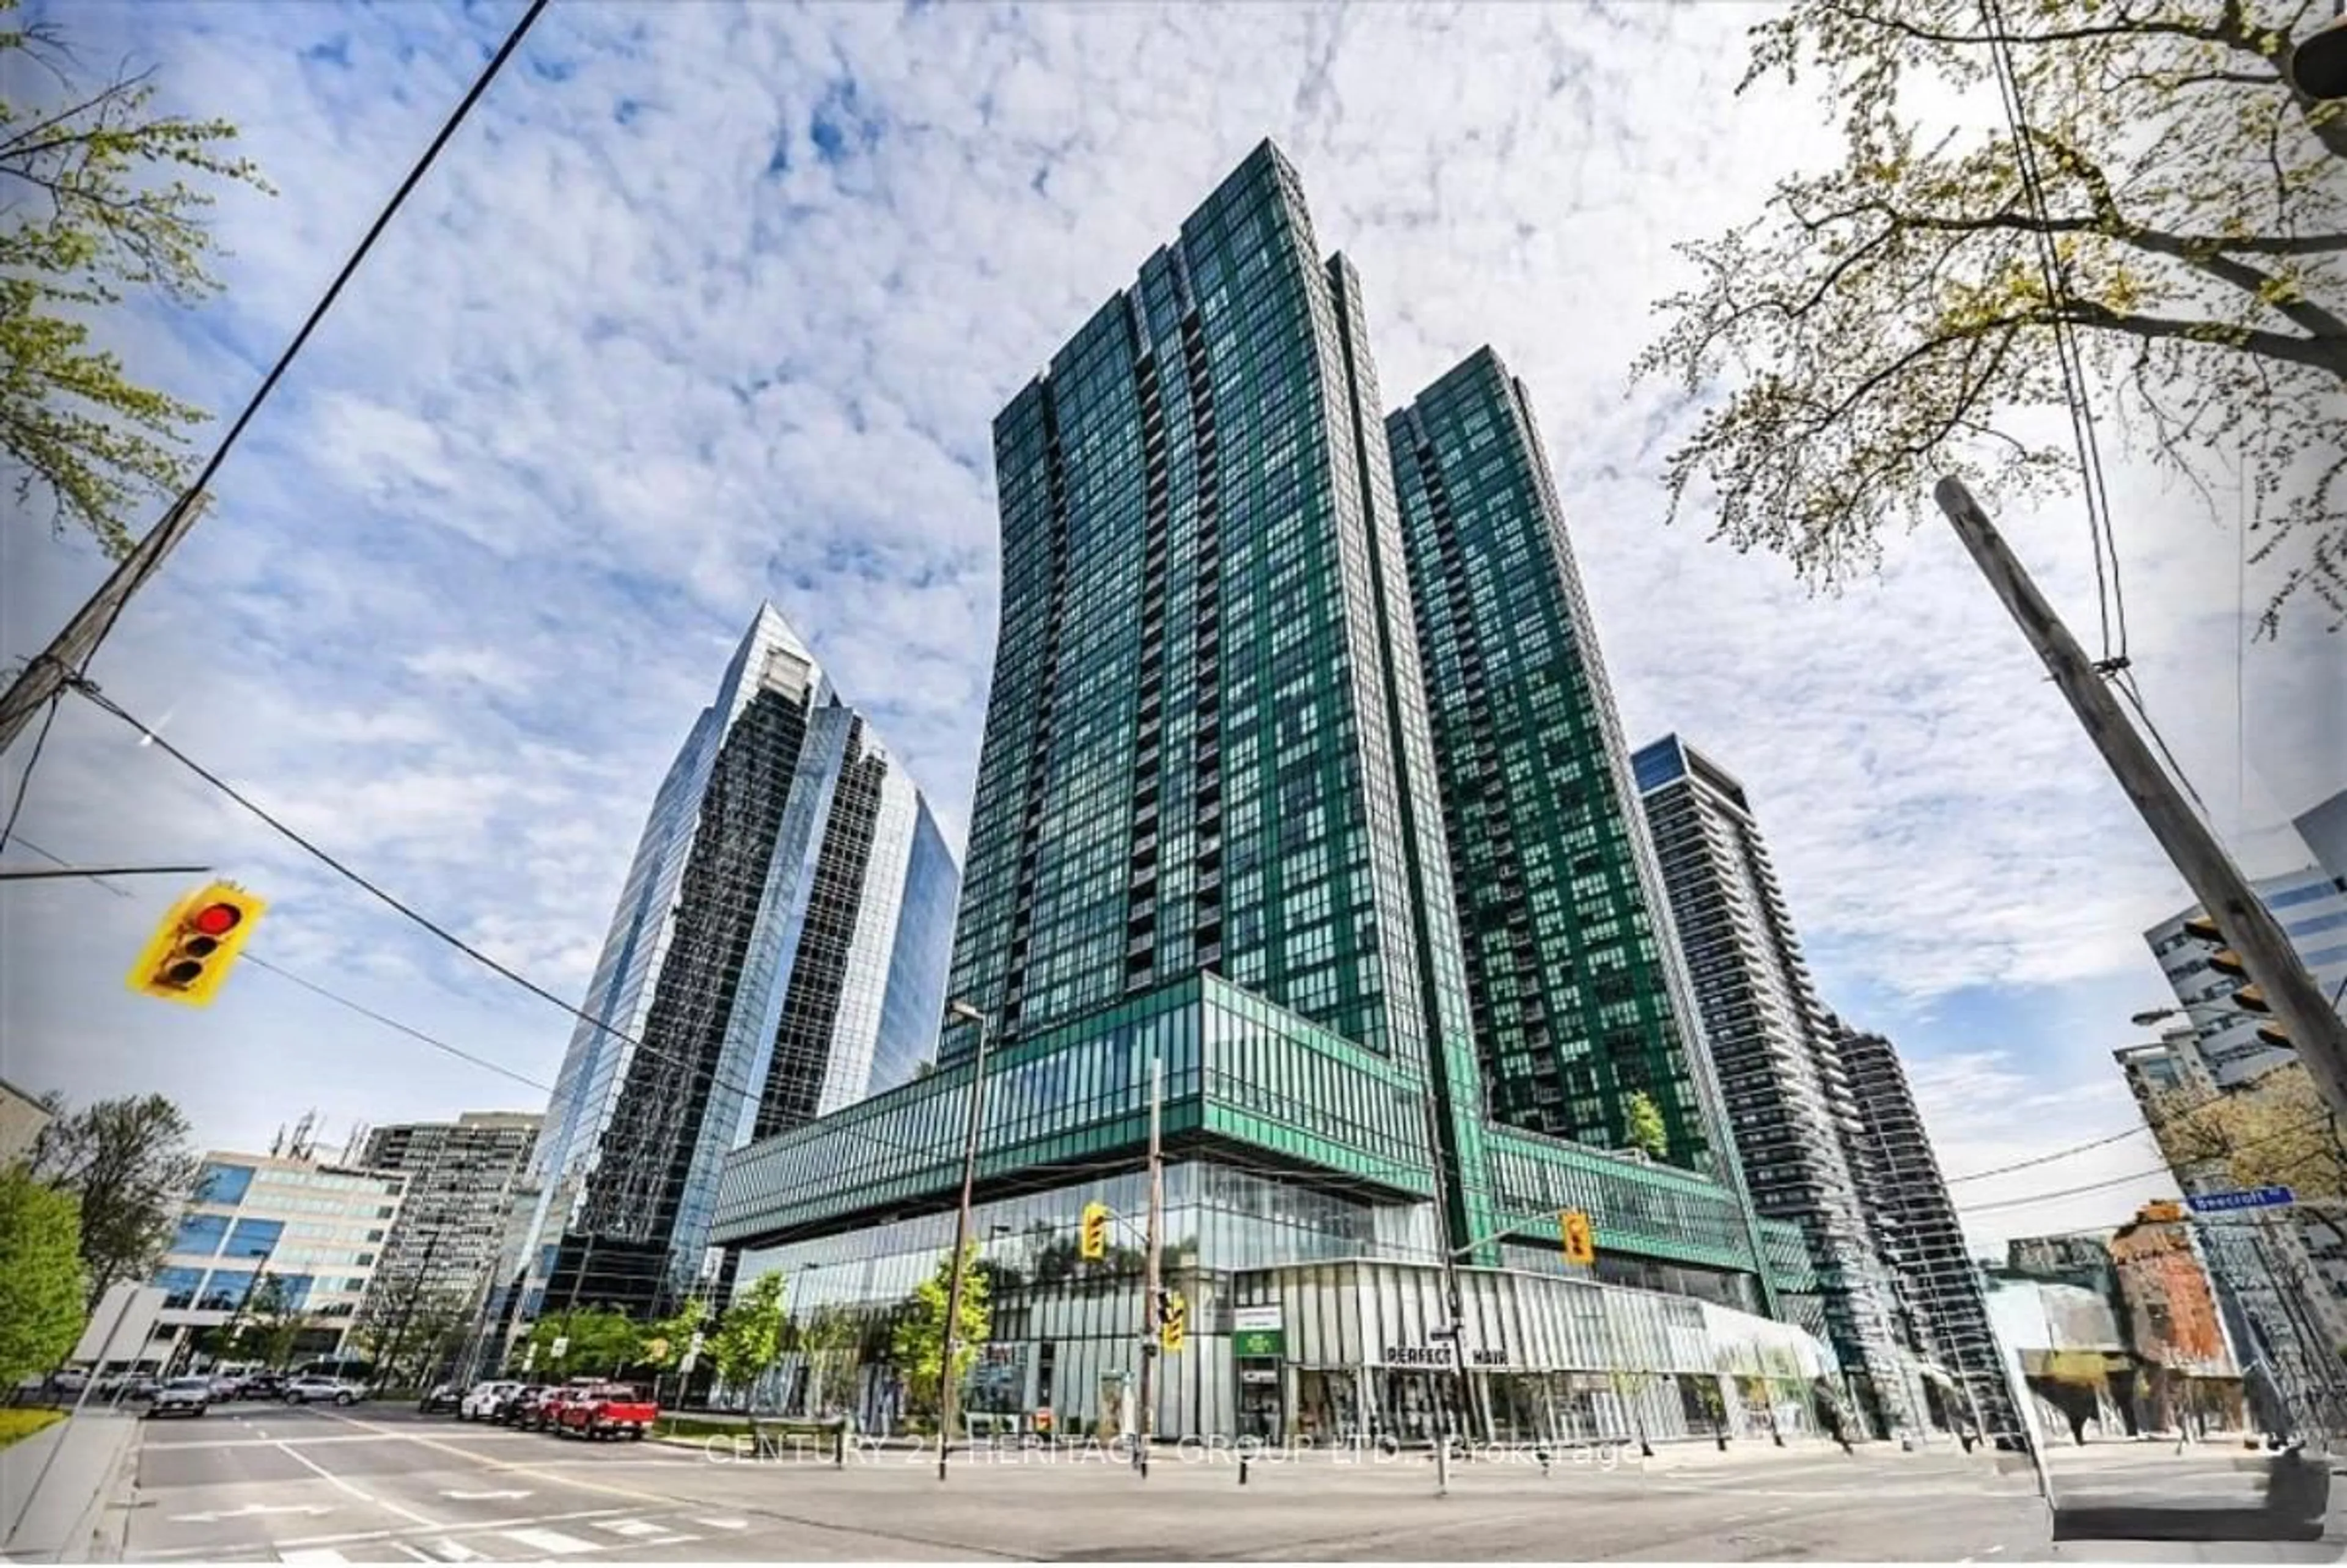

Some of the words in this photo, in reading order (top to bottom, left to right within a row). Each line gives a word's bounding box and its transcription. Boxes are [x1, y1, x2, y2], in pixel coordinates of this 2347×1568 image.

[2195, 1190, 2266, 1211] Beecroft
[1387, 1347, 1450, 1365] PERFECT
[1473, 1349, 1509, 1365] HAIR
